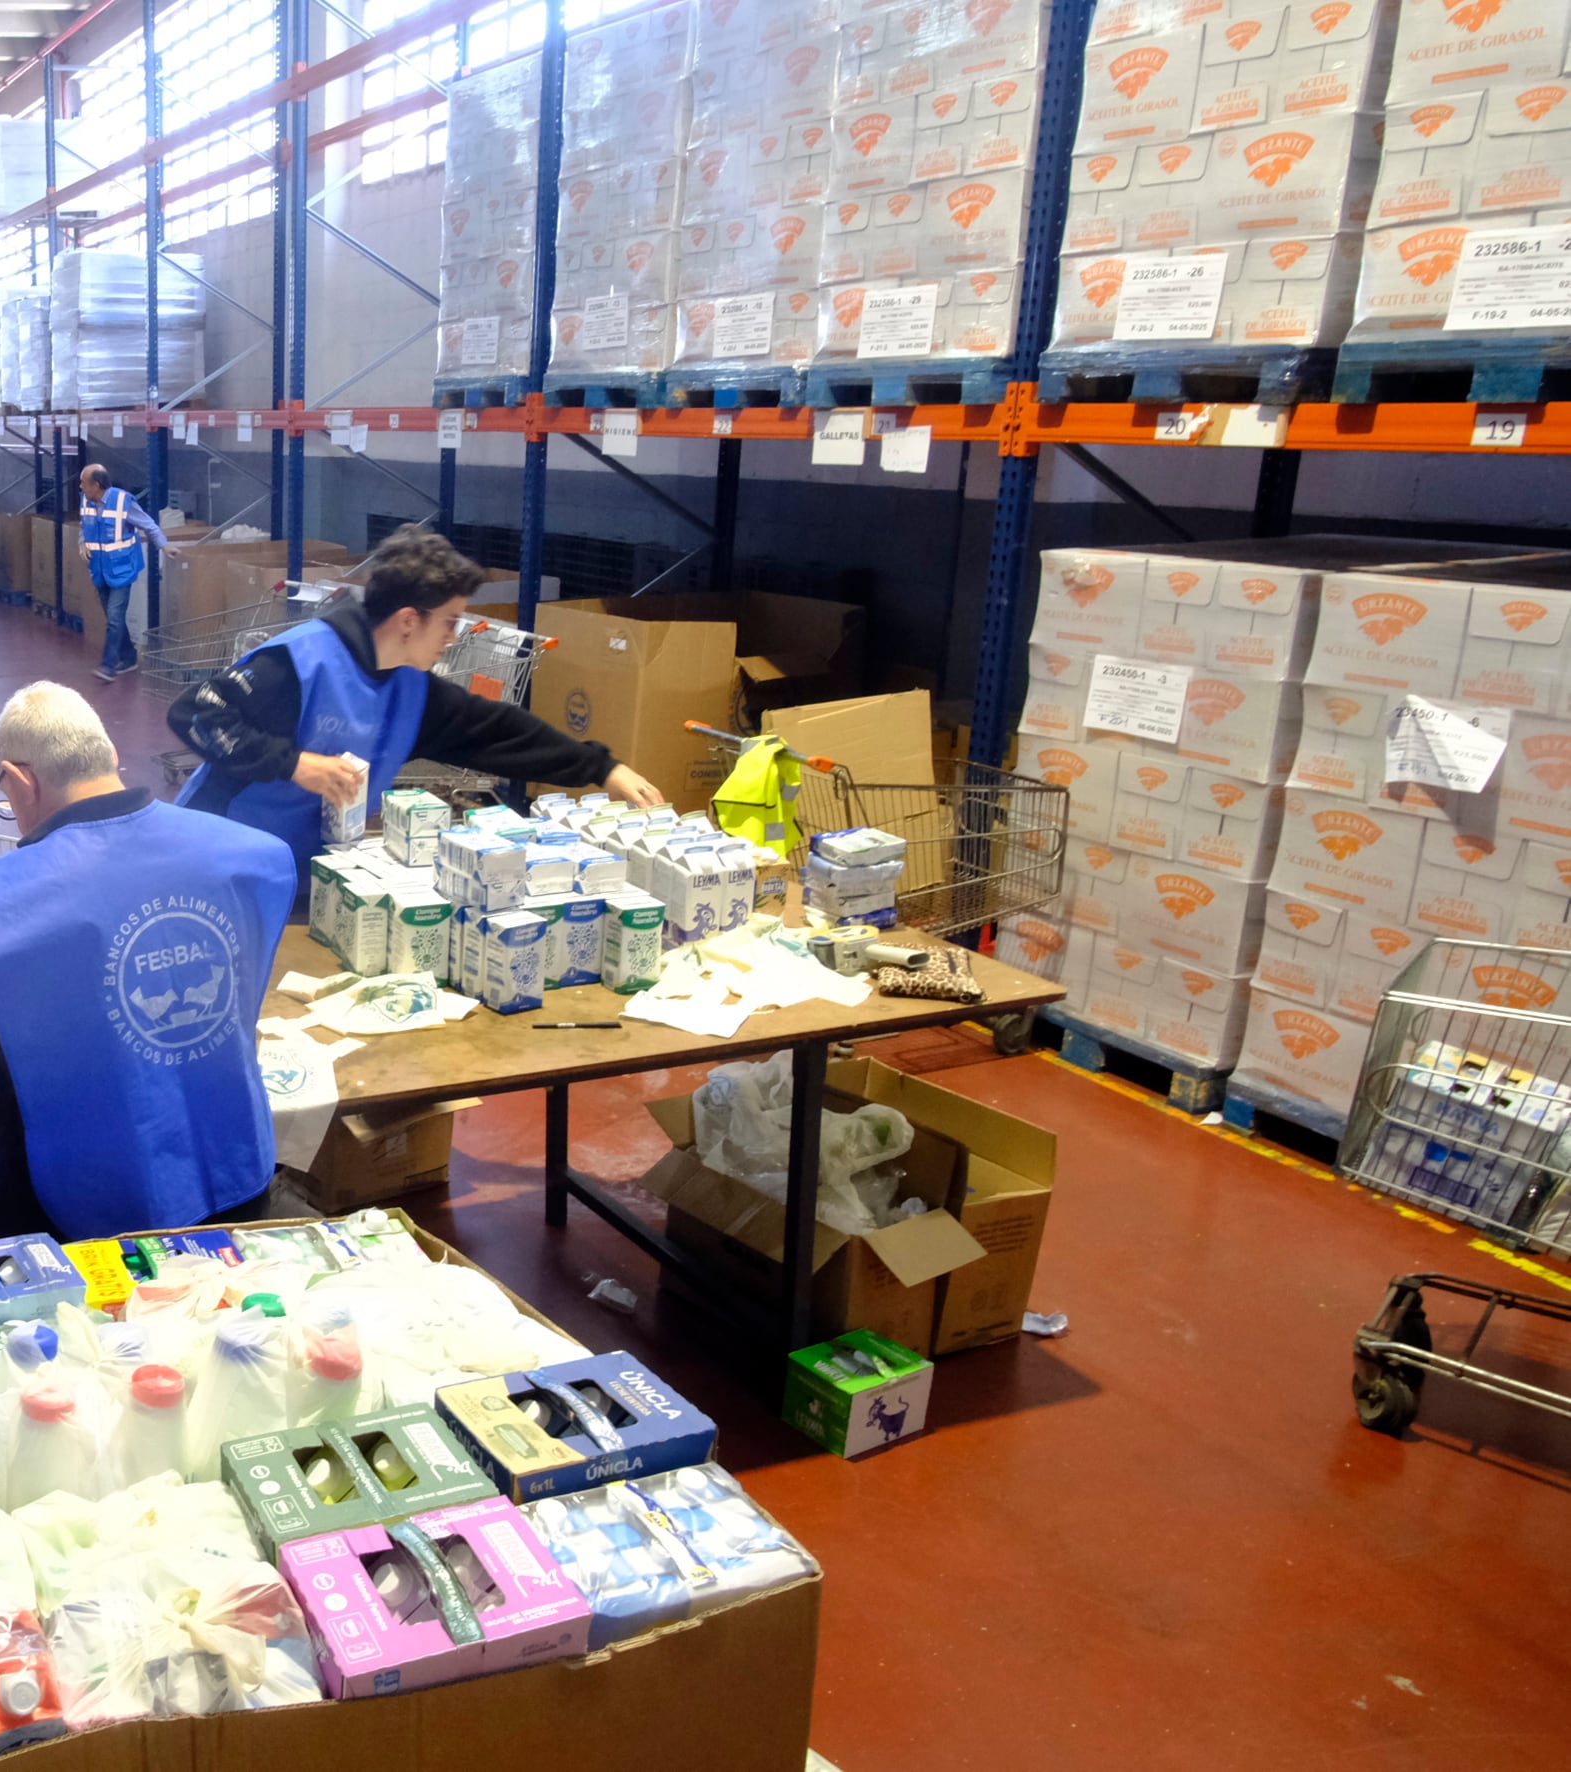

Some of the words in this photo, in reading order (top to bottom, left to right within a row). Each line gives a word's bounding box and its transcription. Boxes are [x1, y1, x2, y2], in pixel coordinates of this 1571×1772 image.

[1408, 42, 1454, 61] ACEITE
[1458, 39, 1477, 53] DE
[1481, 26, 1547, 48] GIRASOL
[1114, 52, 1161, 72] URZANTE
[1299, 74, 1339, 88] ACEITE
[1249, 137, 1308, 157] URZANTE
[1218, 196, 1254, 208] ACEITE
[1257, 194, 1273, 205] DE
[1276, 189, 1327, 203] GIRASOL
[1474, 240, 1542, 257] 232586-1
[1132, 267, 1177, 280] 232586-1
[1187, 267, 1203, 278] -26
[1472, 310, 1507, 320] F-19-2
[718, 421, 729, 432] 22
[819, 432, 859, 440] GALLETAS
[1164, 419, 1185, 435] 20
[1486, 420, 1515, 440] 19
[1360, 600, 1420, 617] URZANTE
[1157, 675, 1167, 685] -3
[1320, 814, 1376, 838] URZANTE
[693, 874, 721, 888] LEYMA
[729, 869, 754, 884] LEYMA
[1285, 854, 1323, 871] ACEITE
[1326, 863, 1342, 875] DE
[1344, 869, 1393, 889] GIRASOL
[414, 914, 442, 922] Nuestro
[570, 909, 597, 917] Nuestro
[632, 916, 659, 924] Nuestro
[103, 913, 140, 986] BANCOS
[141, 898, 163, 917] DE
[167, 895, 240, 956] ALIMENTOS
[134, 940, 217, 975] FESBAL
[1281, 1012, 1331, 1041] URZANTE
[106, 1008, 161, 1065] BANCOS
[165, 1054, 184, 1066] DE
[79, 1247, 100, 1268] BRIK
[89, 1264, 125, 1299] GRATIS
[608, 1377, 630, 1399] LECHE
[624, 1391, 651, 1419] ENTERA
[619, 1370, 683, 1421] ÚNICLA
[530, 1478, 556, 1494] 6x1L
[586, 1456, 643, 1482] ÚNICLA
[282, 1463, 305, 1489] Método
[296, 1485, 319, 1511] Feiraco
[490, 1522, 538, 1574] FEIRACO
[349, 1571, 373, 1602] Método
[365, 1599, 390, 1633] Feiraco
